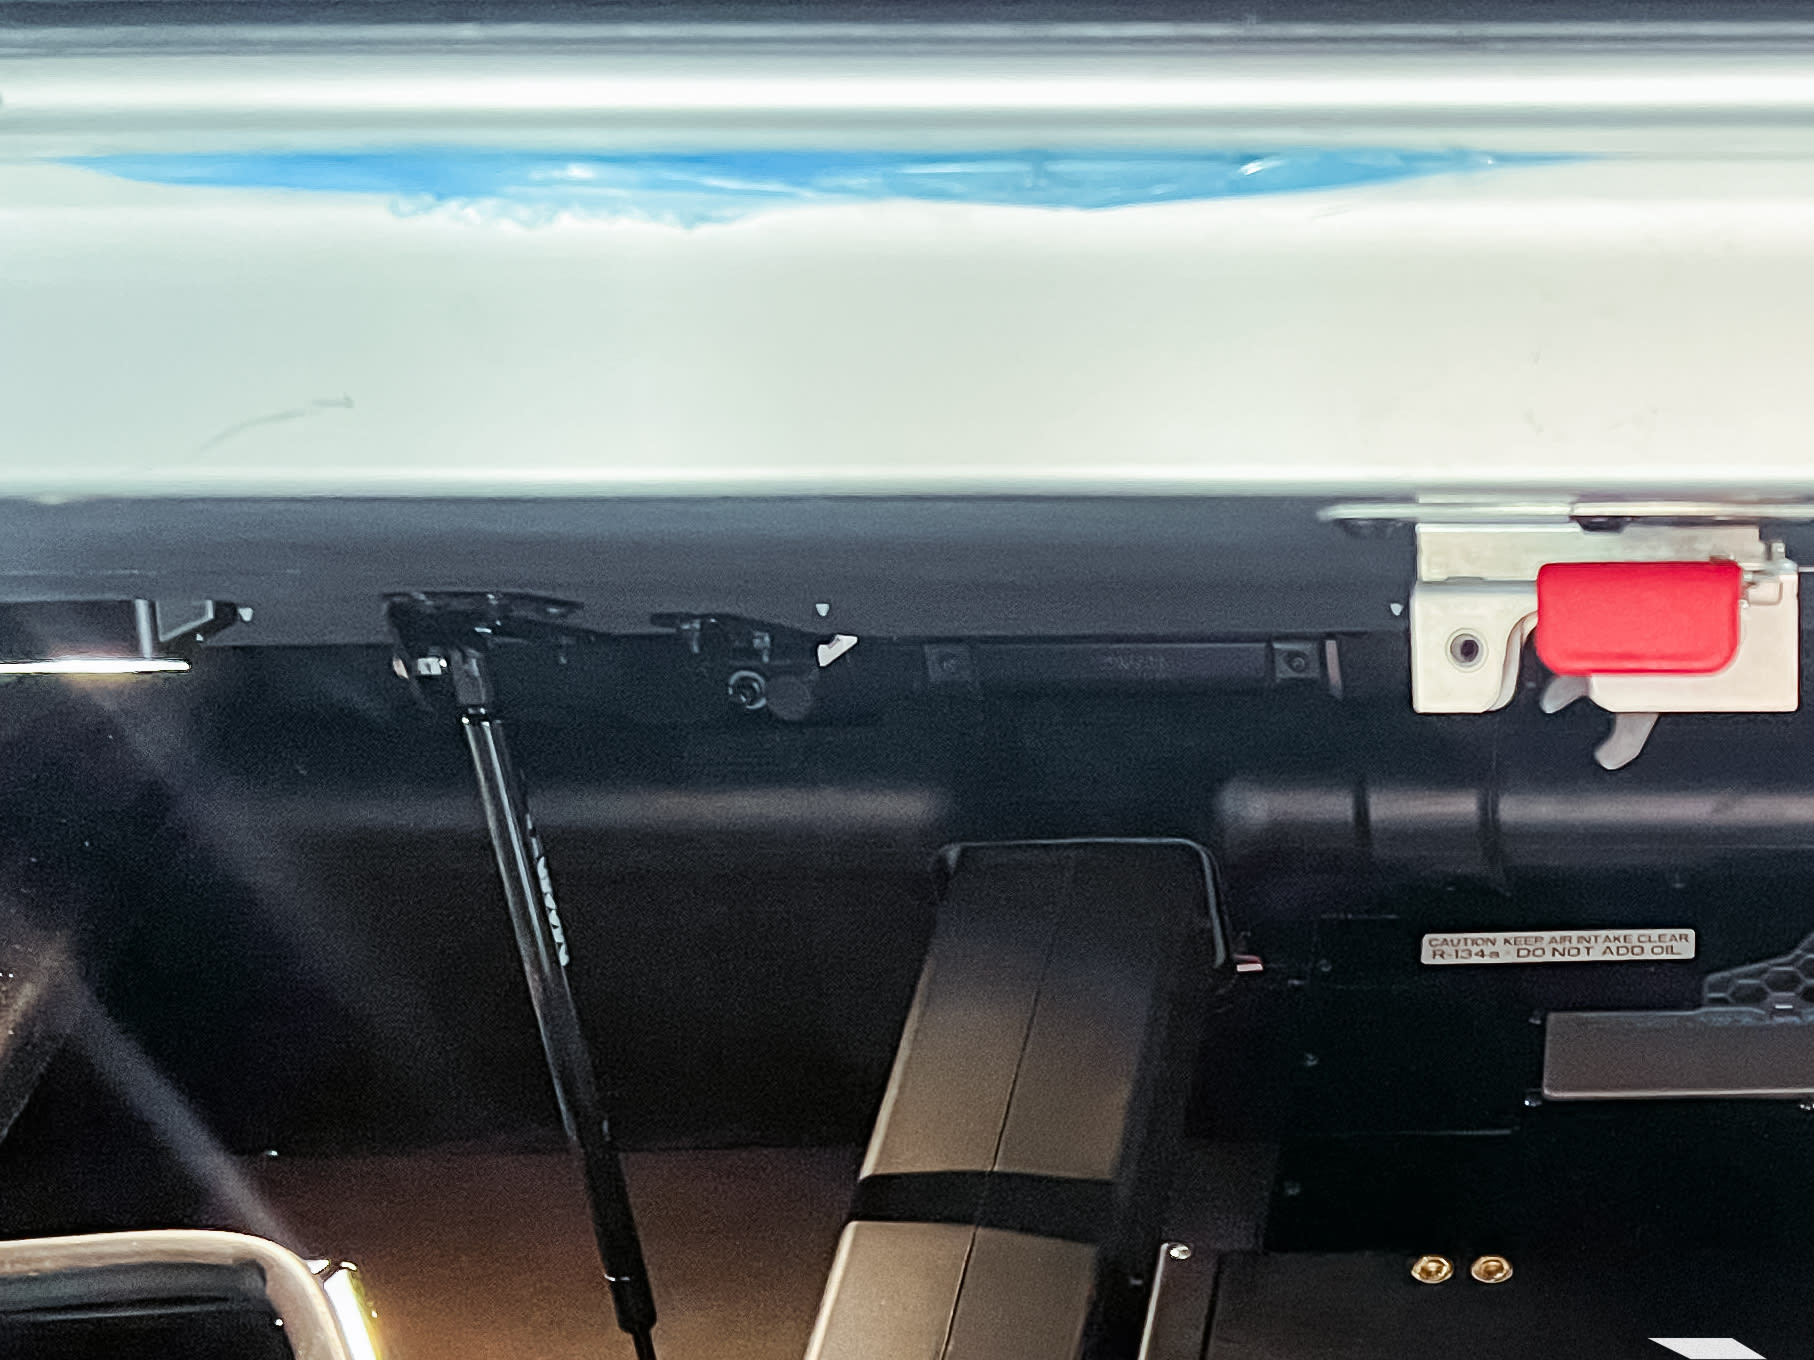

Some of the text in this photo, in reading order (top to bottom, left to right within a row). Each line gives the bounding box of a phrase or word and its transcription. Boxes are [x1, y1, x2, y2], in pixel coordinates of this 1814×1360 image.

[1428, 933, 1689, 947] CAUTION KEEP AIR INTAKE CLEAR
[1432, 944, 1682, 960] R-134a DO NOT ADD OIL
